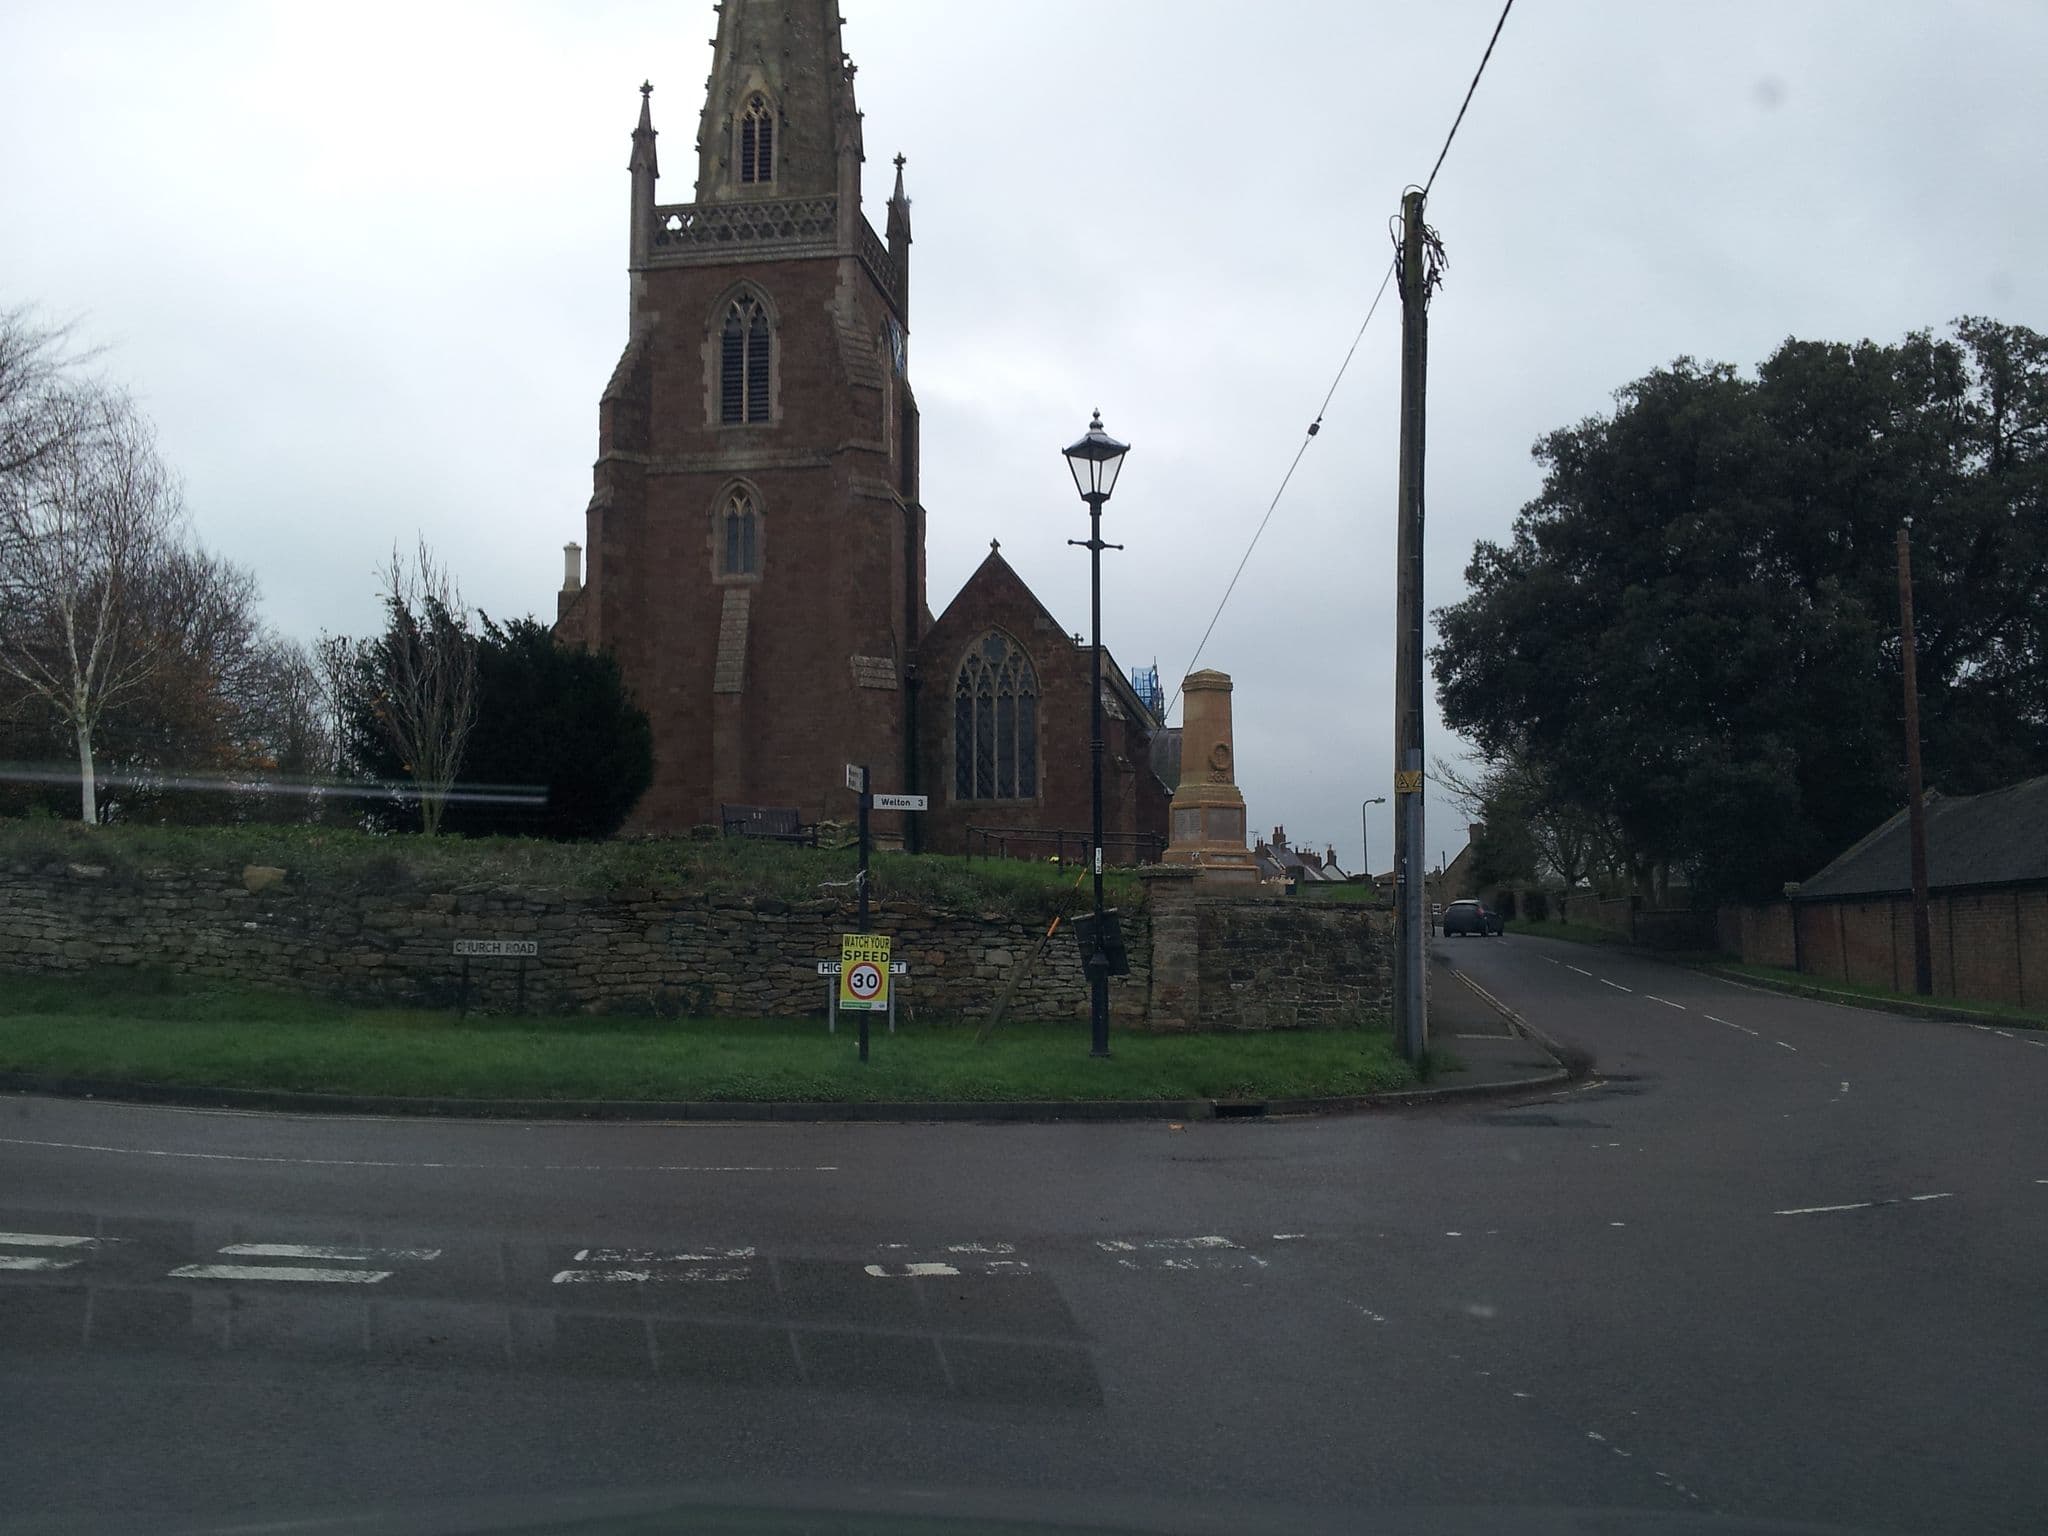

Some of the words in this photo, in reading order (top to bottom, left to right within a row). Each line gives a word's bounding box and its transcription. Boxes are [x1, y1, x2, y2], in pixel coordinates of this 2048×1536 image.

[881, 798, 911, 806] Welton
[918, 799, 924, 807] 3
[456, 942, 501, 953] CHURCH
[506, 943, 536, 954] ROAD
[844, 936, 869, 949] WATCH
[871, 937, 890, 950] YOUR
[843, 950, 889, 963] SPEED
[821, 963, 842, 973] HIG
[853, 973, 878, 989] 30
